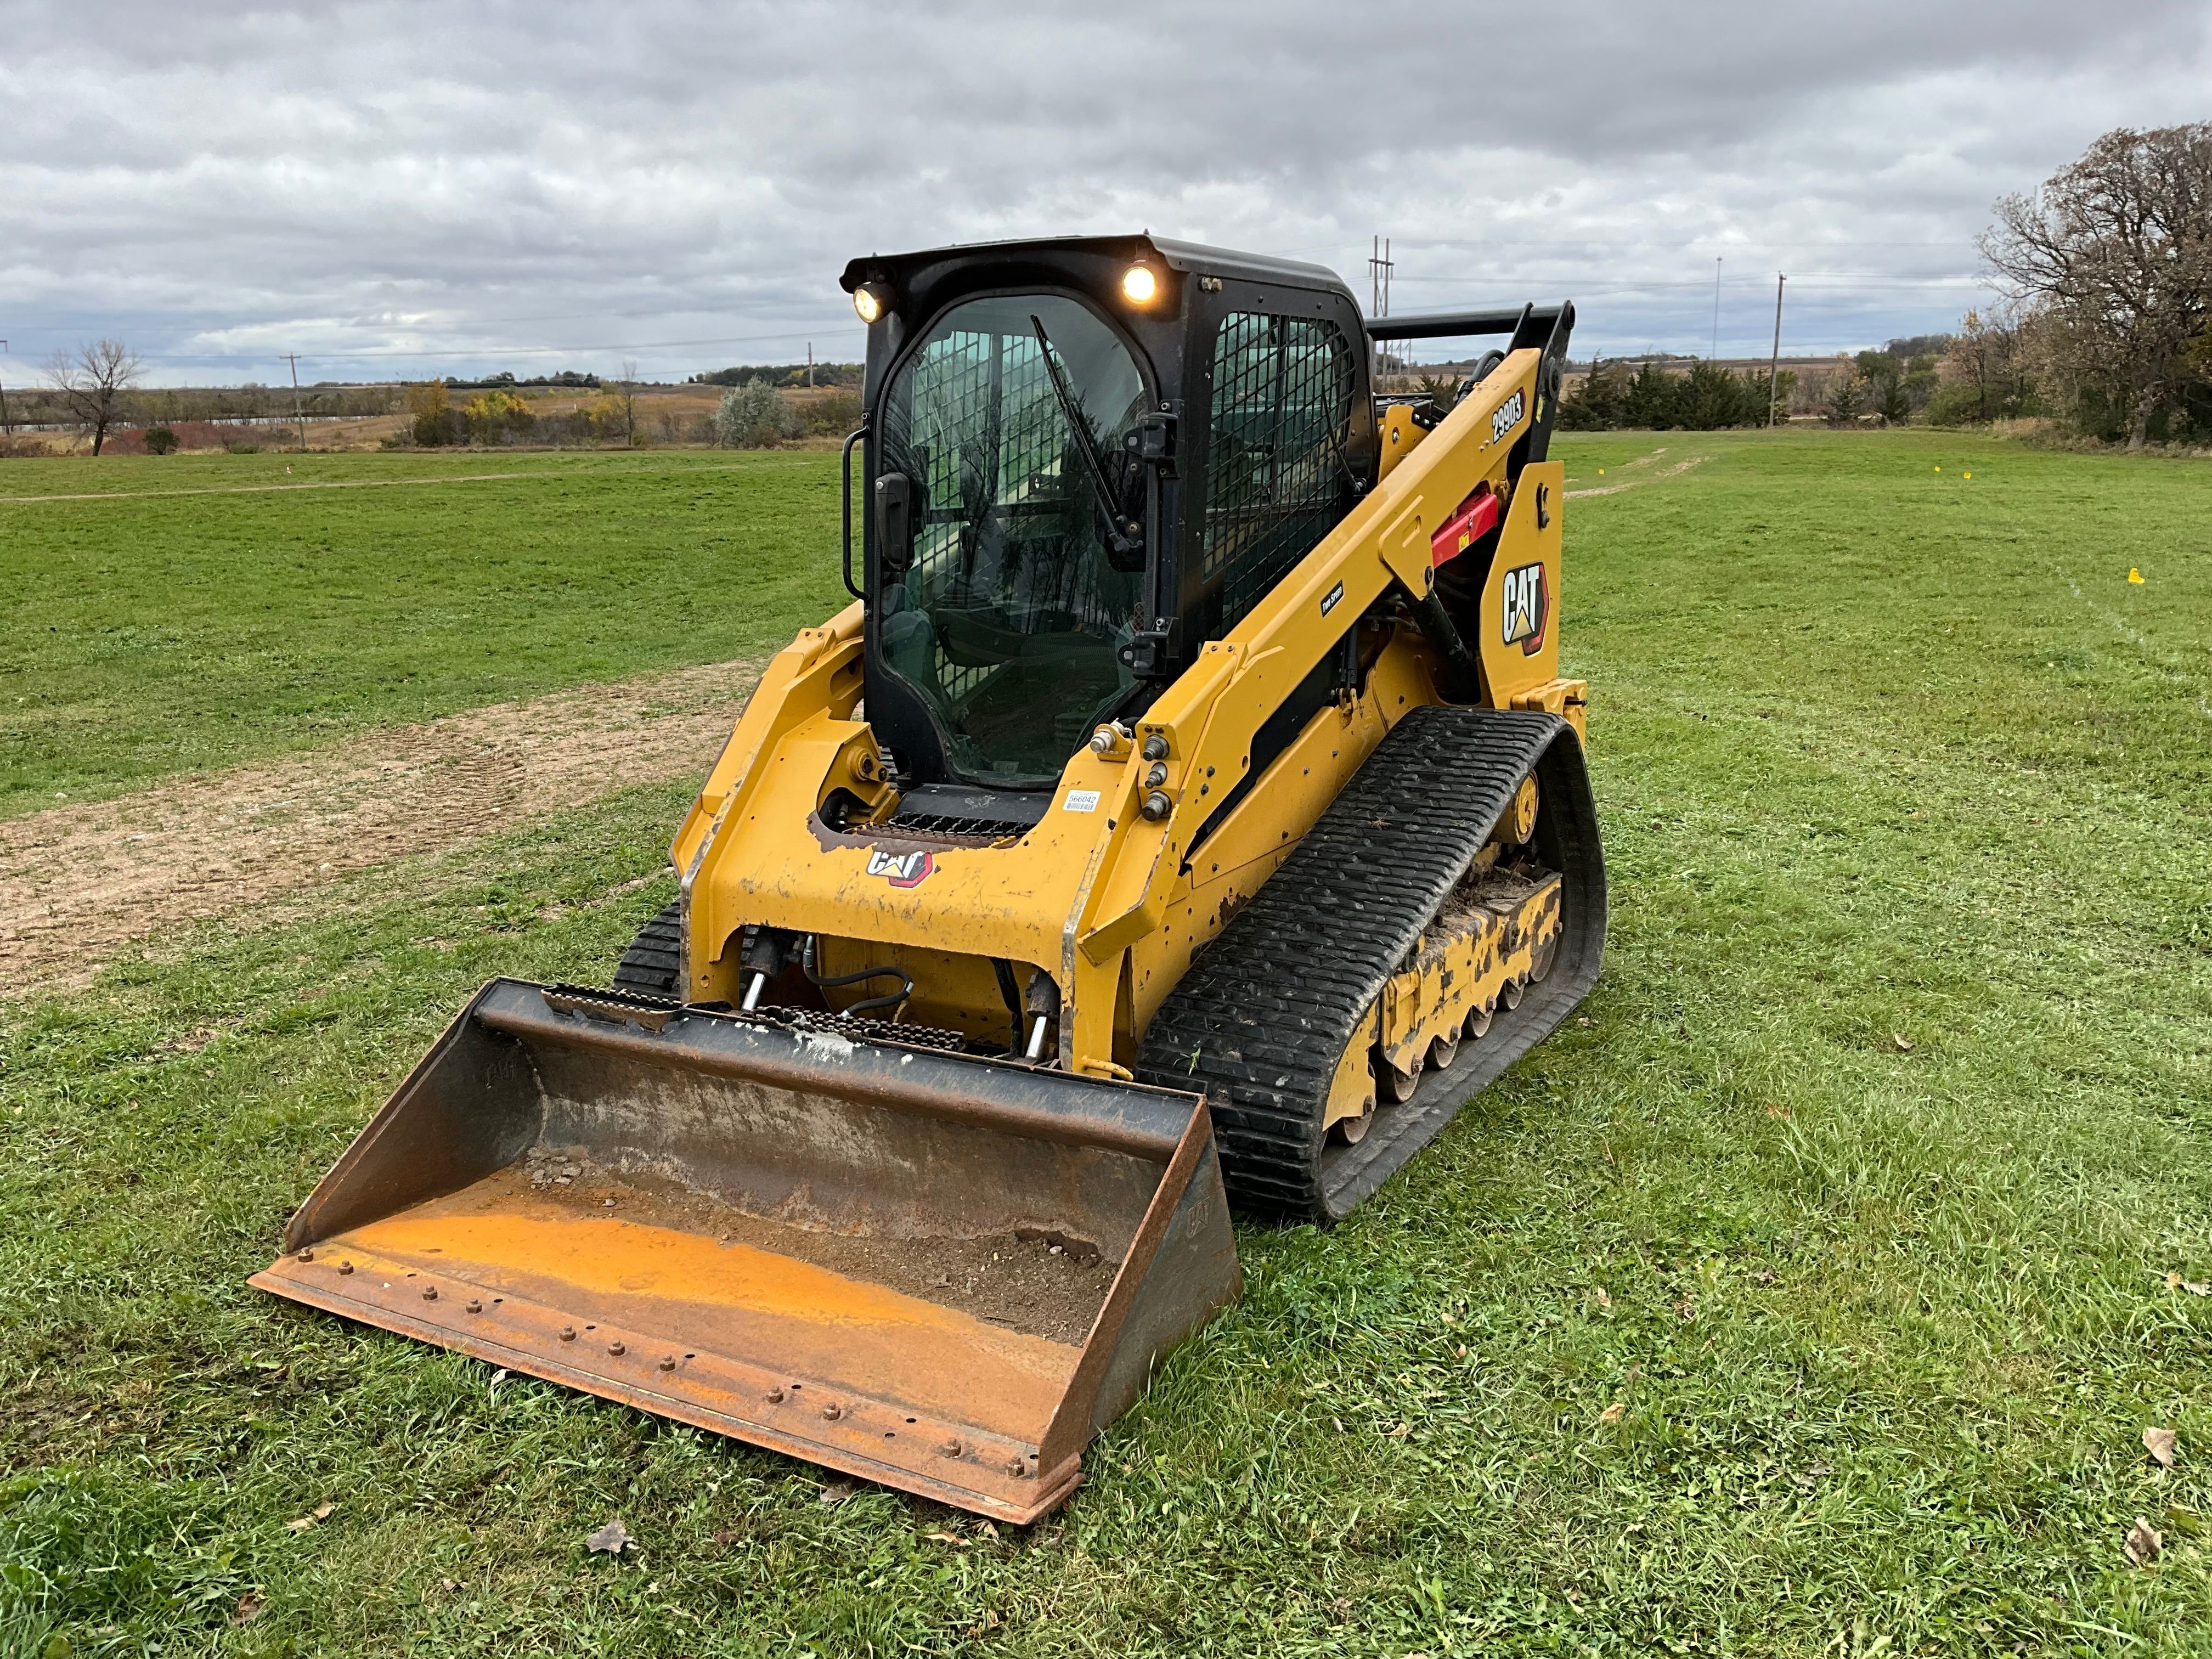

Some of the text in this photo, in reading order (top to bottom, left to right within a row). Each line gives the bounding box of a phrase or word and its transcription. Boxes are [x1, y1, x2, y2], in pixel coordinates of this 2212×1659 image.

[1492, 392, 1522, 443] 299D3
[1503, 565, 1539, 642] CAT
[1069, 795, 1096, 803] 566042
